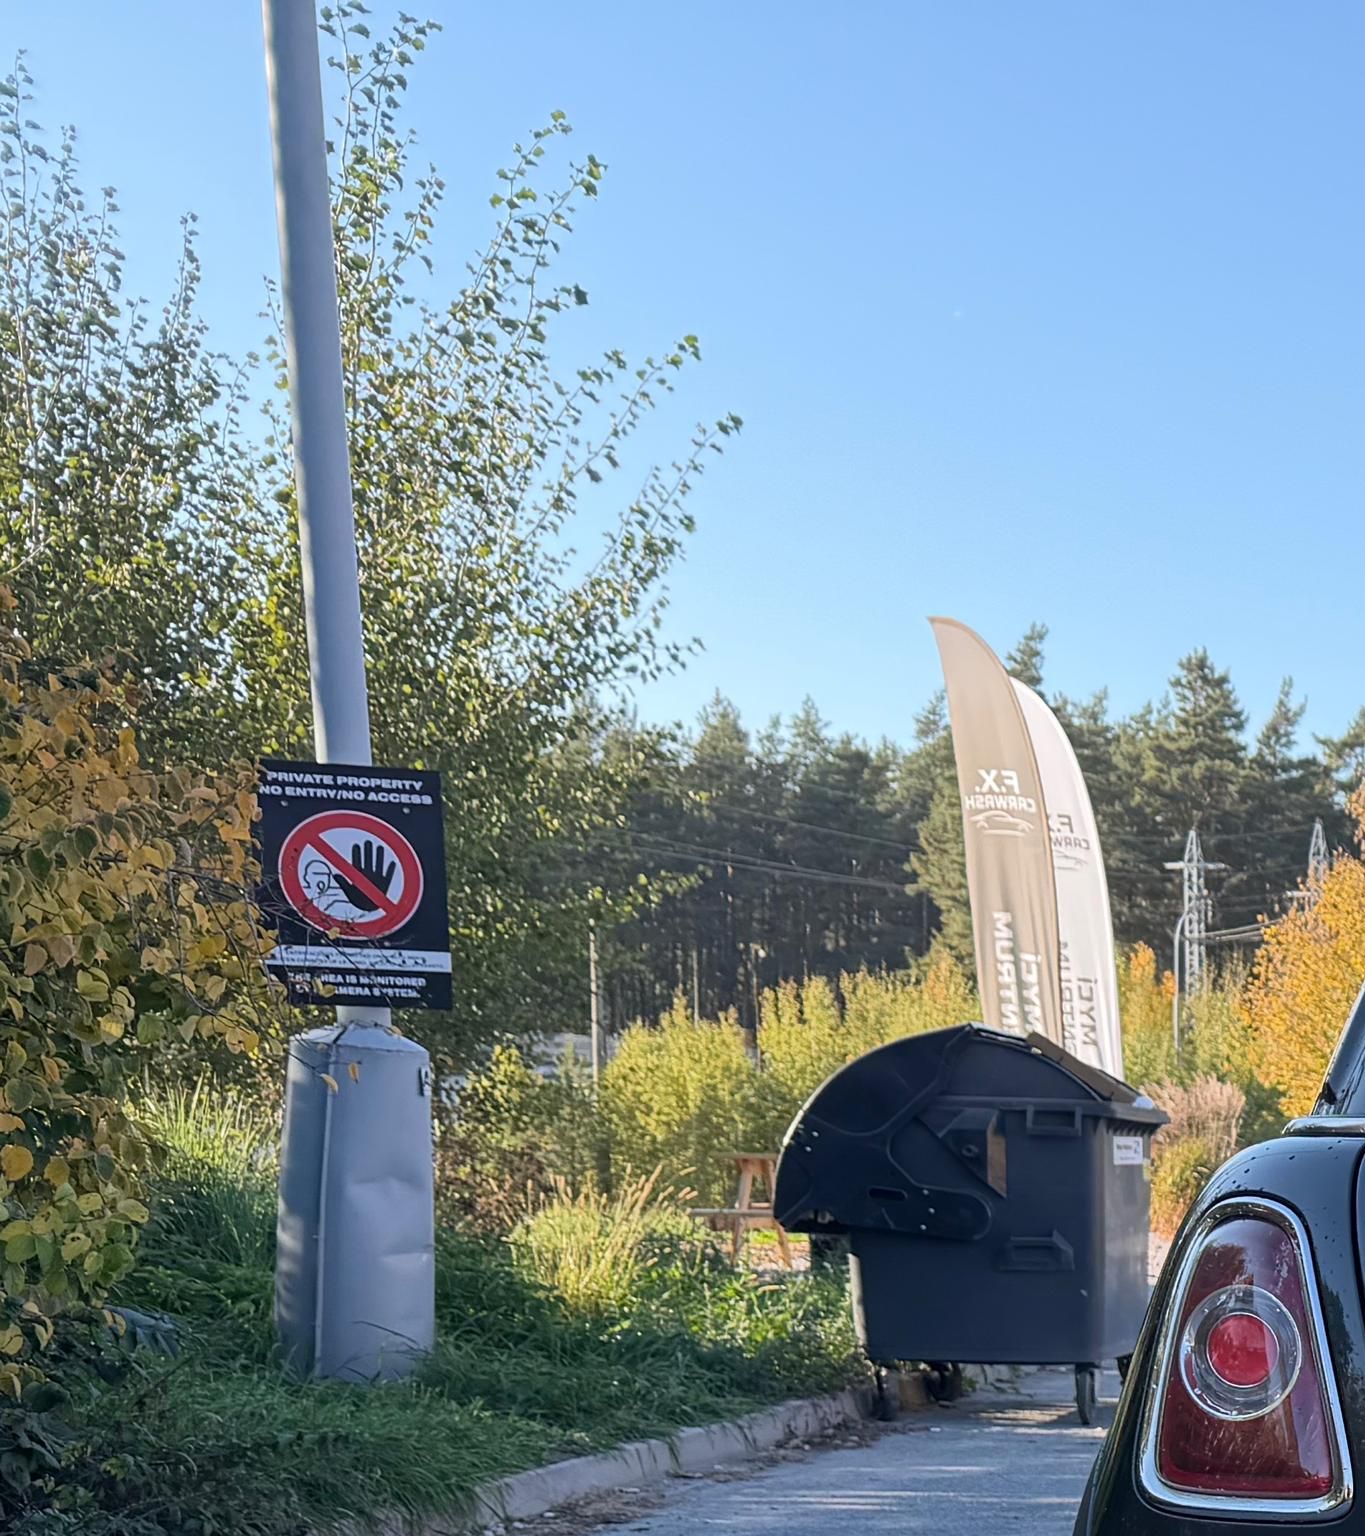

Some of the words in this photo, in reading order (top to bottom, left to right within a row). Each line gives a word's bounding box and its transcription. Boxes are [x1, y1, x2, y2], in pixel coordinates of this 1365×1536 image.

[267, 771, 334, 785] PRIVATE
[336, 776, 423, 791] PROPERTY
[259, 784, 283, 795] NO
[284, 786, 365, 801] ENTRY/NO
[368, 791, 433, 805] ACCESS
[321, 974, 344, 984] REA
[345, 974, 357, 984] IS
